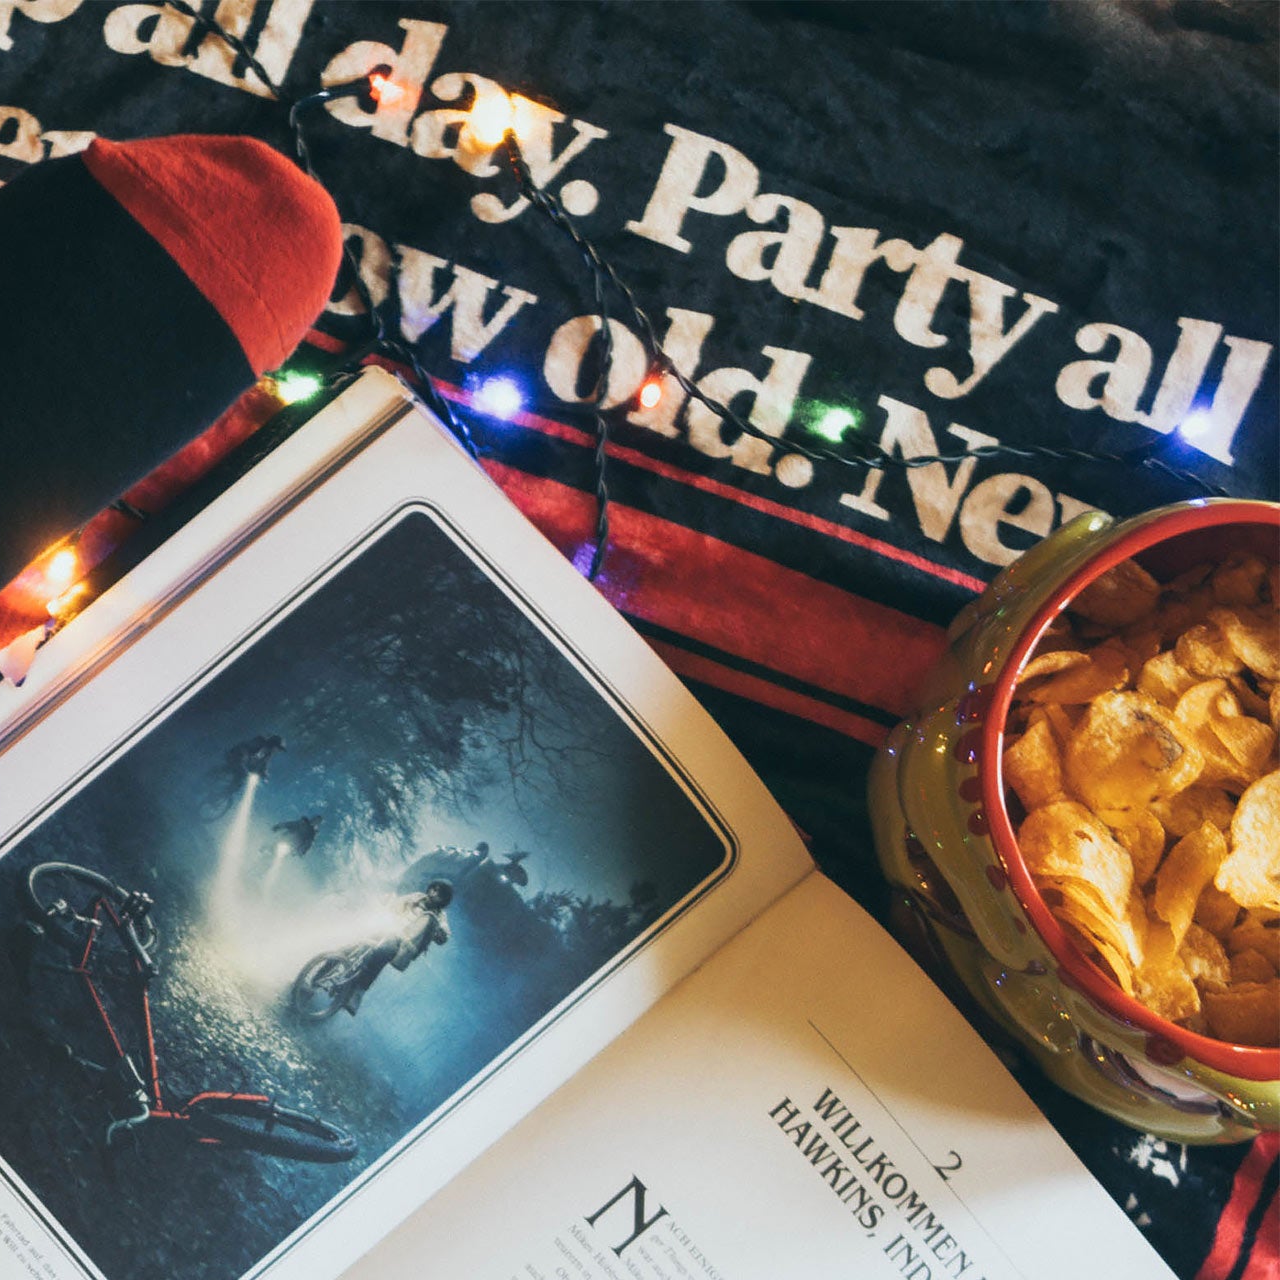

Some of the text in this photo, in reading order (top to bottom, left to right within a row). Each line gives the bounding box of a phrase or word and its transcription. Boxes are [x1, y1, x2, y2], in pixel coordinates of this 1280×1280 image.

[322, 17, 608, 224] day.
[625, 122, 1057, 398] Party
[1056, 316, 1274, 466] all
[543, 307, 814, 489] old.
[767, 1097, 885, 1239] HAWKINS,
[812, 1087, 974, 1280] WILLKOMMEN
[933, 1150, 963, 1181] 2
